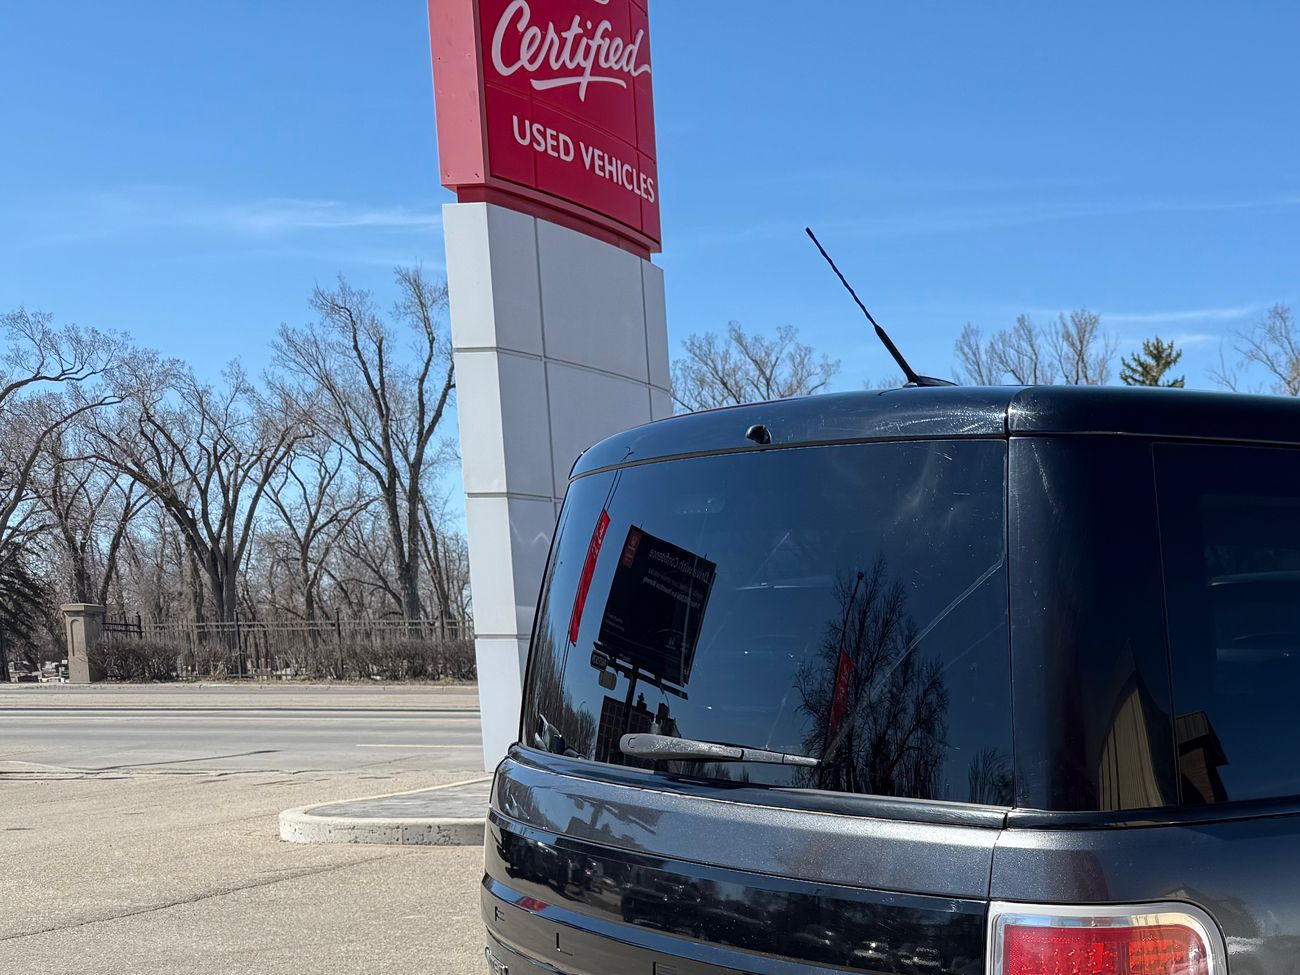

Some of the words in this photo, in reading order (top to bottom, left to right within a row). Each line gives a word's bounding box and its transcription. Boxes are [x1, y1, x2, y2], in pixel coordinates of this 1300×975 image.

[491, 0, 652, 102] Certified
[512, 115, 575, 163] USED
[579, 141, 655, 204] VEHICLES
